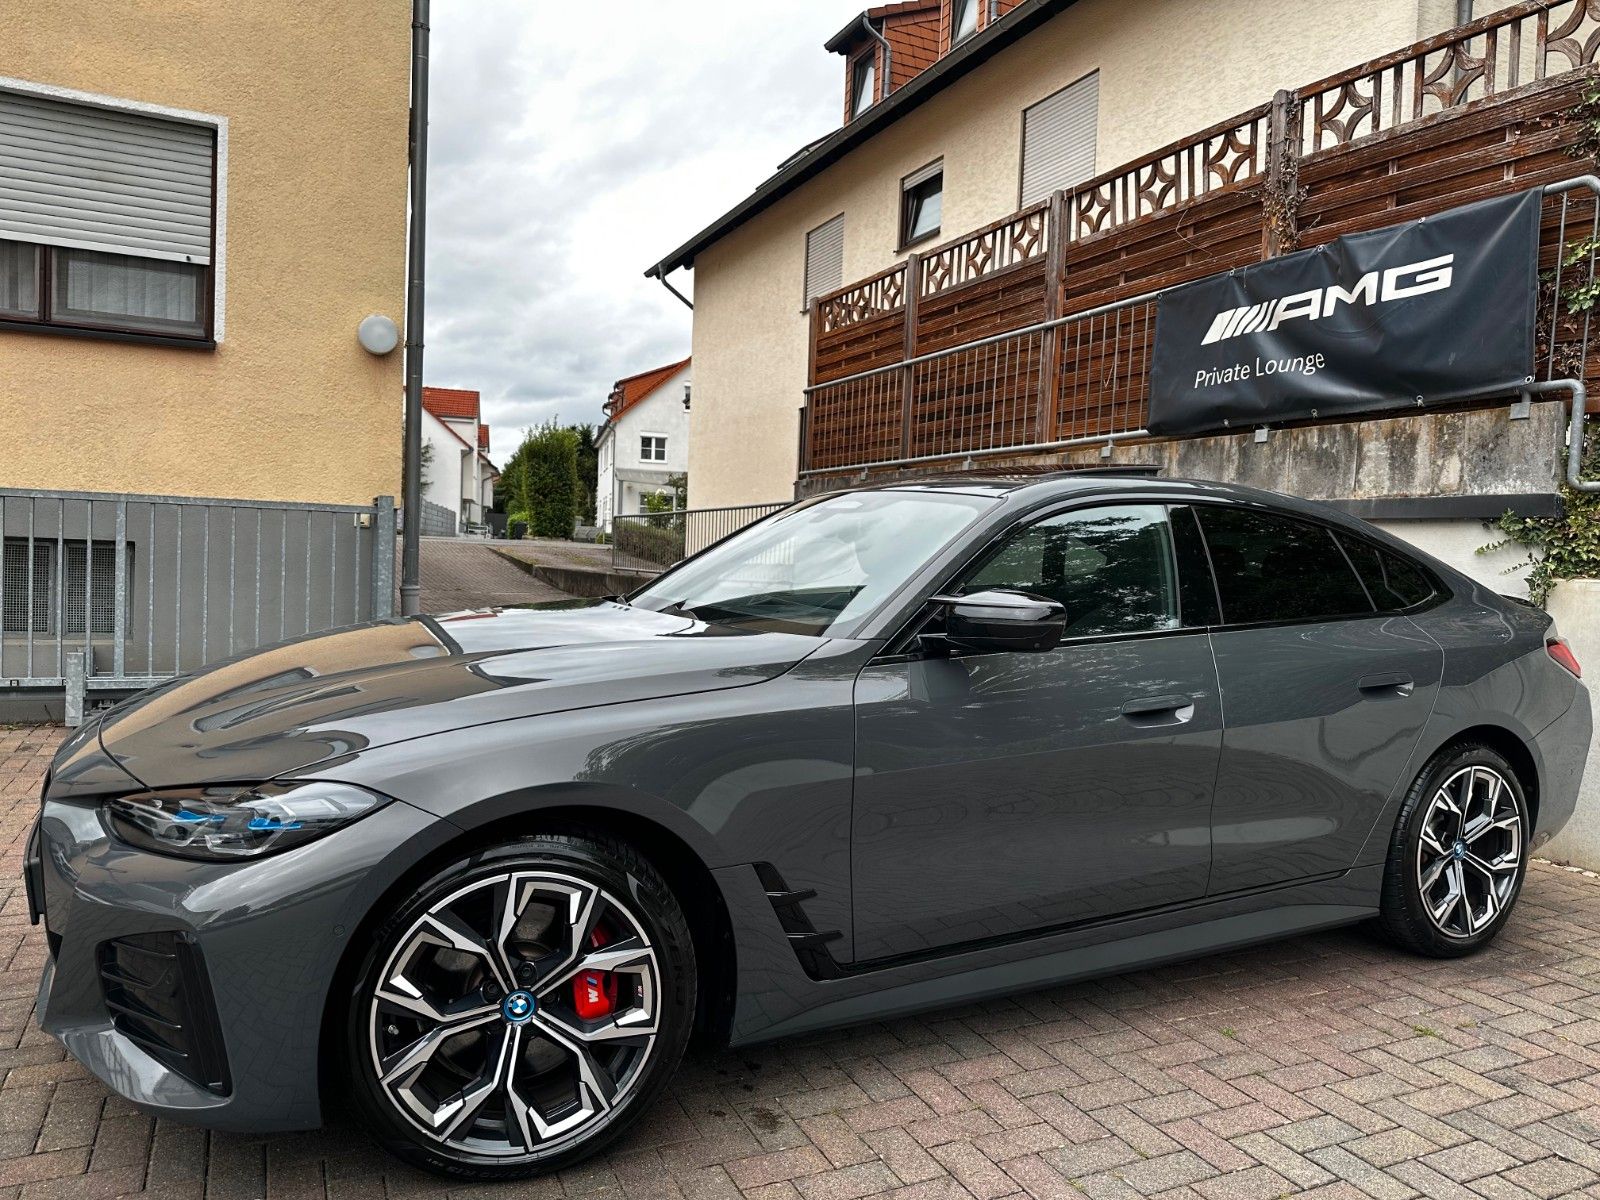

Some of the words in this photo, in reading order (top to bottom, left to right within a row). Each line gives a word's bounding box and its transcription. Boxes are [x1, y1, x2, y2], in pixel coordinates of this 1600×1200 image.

[1271, 253, 1454, 331] AMG
[1194, 364, 1250, 388] Private
[1256, 353, 1325, 376] Lounge
